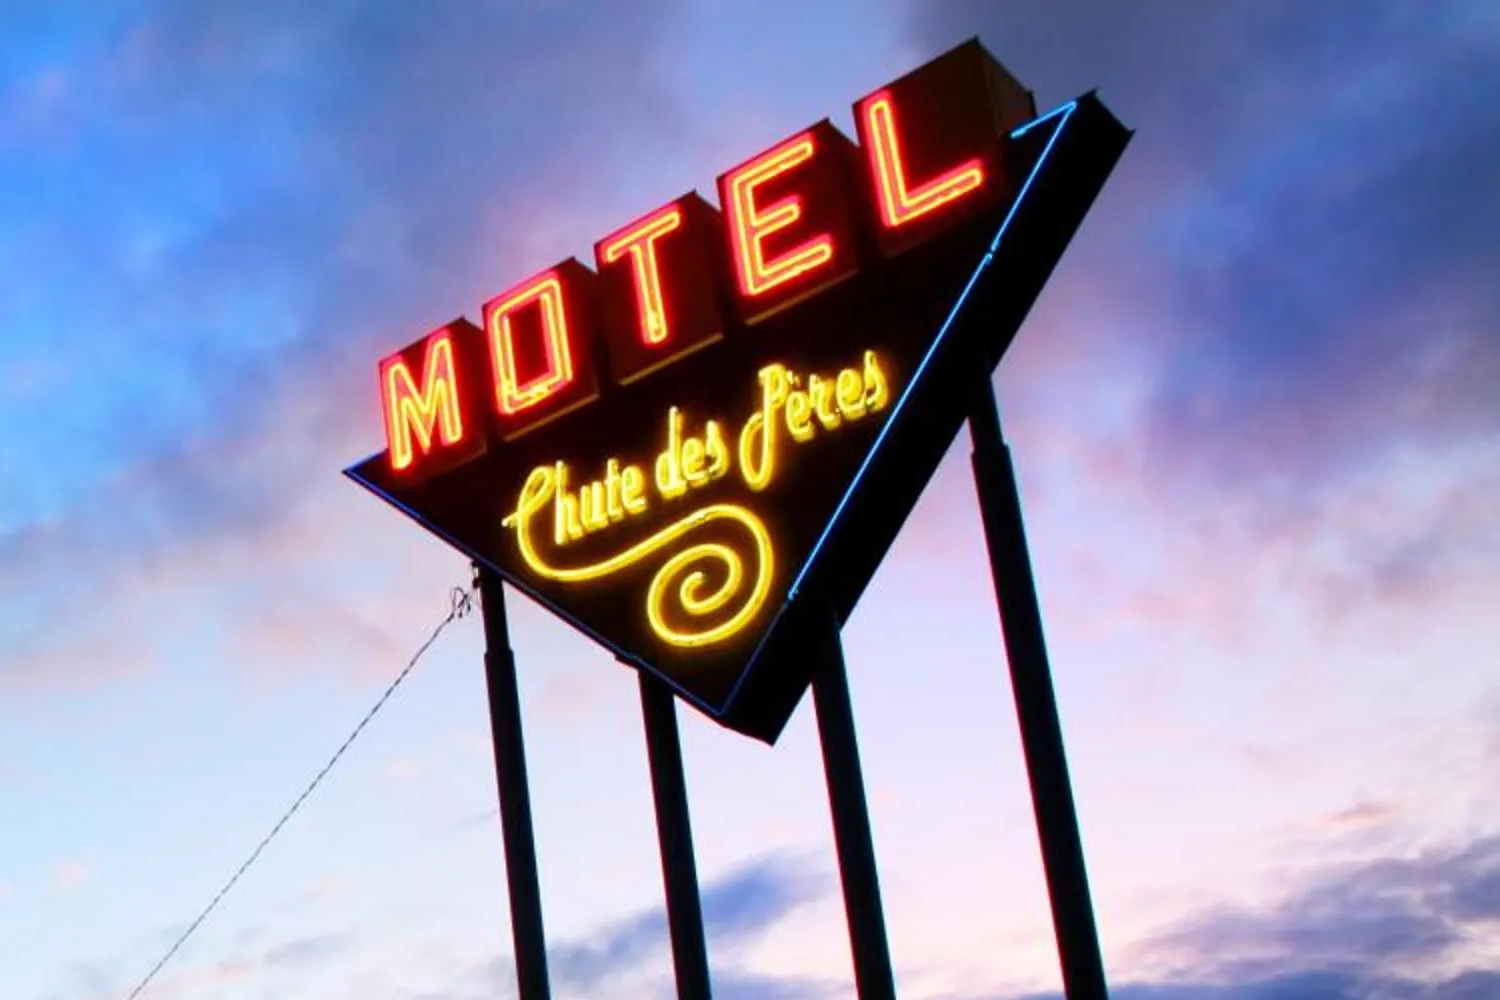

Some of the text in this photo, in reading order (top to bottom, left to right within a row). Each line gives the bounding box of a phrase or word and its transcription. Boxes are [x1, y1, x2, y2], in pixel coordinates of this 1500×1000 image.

[379, 89, 986, 473] MOTEL
[501, 349, 889, 582] Chute des Pères
